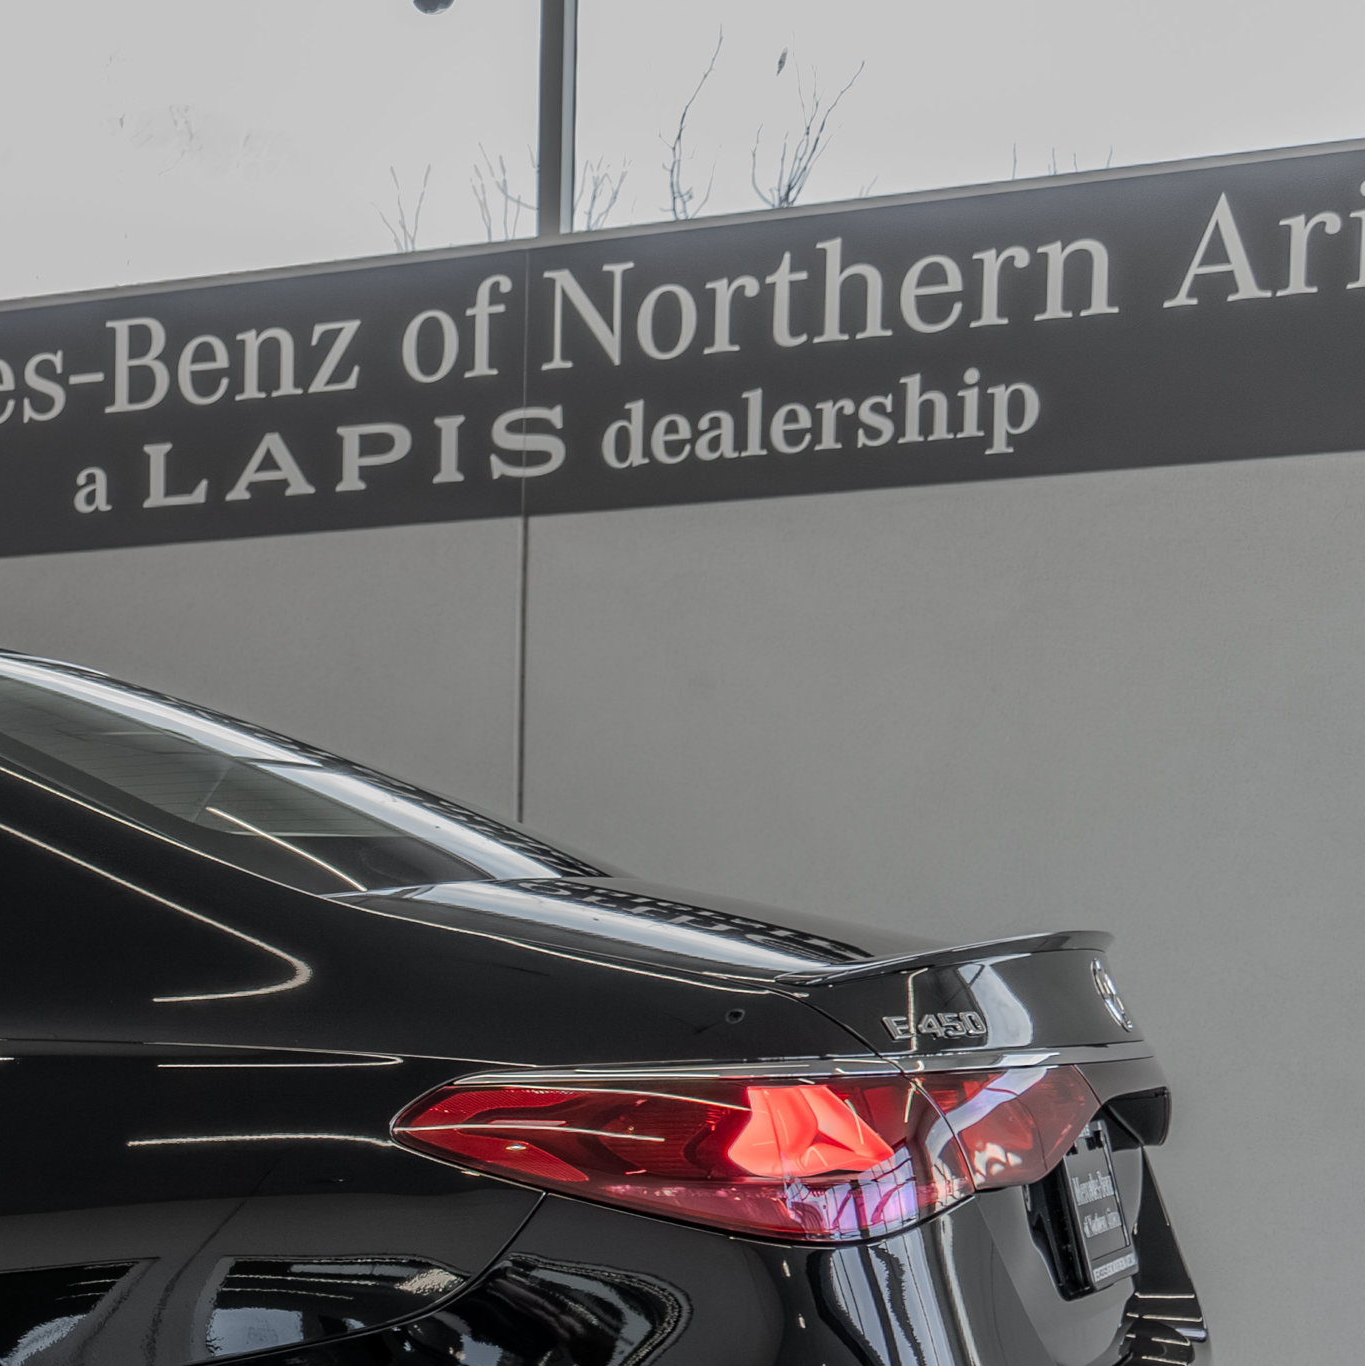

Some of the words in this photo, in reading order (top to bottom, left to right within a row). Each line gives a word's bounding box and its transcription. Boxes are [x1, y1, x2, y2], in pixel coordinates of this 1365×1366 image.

[401, 273, 513, 384] of
[540, 236, 1120, 371] Northern
[73, 466, 113, 514] a
[142, 397, 566, 509] LAPIS
[601, 367, 1041, 469] dealership
[881, 1016, 914, 1040] E
[917, 1011, 987, 1039] 450
